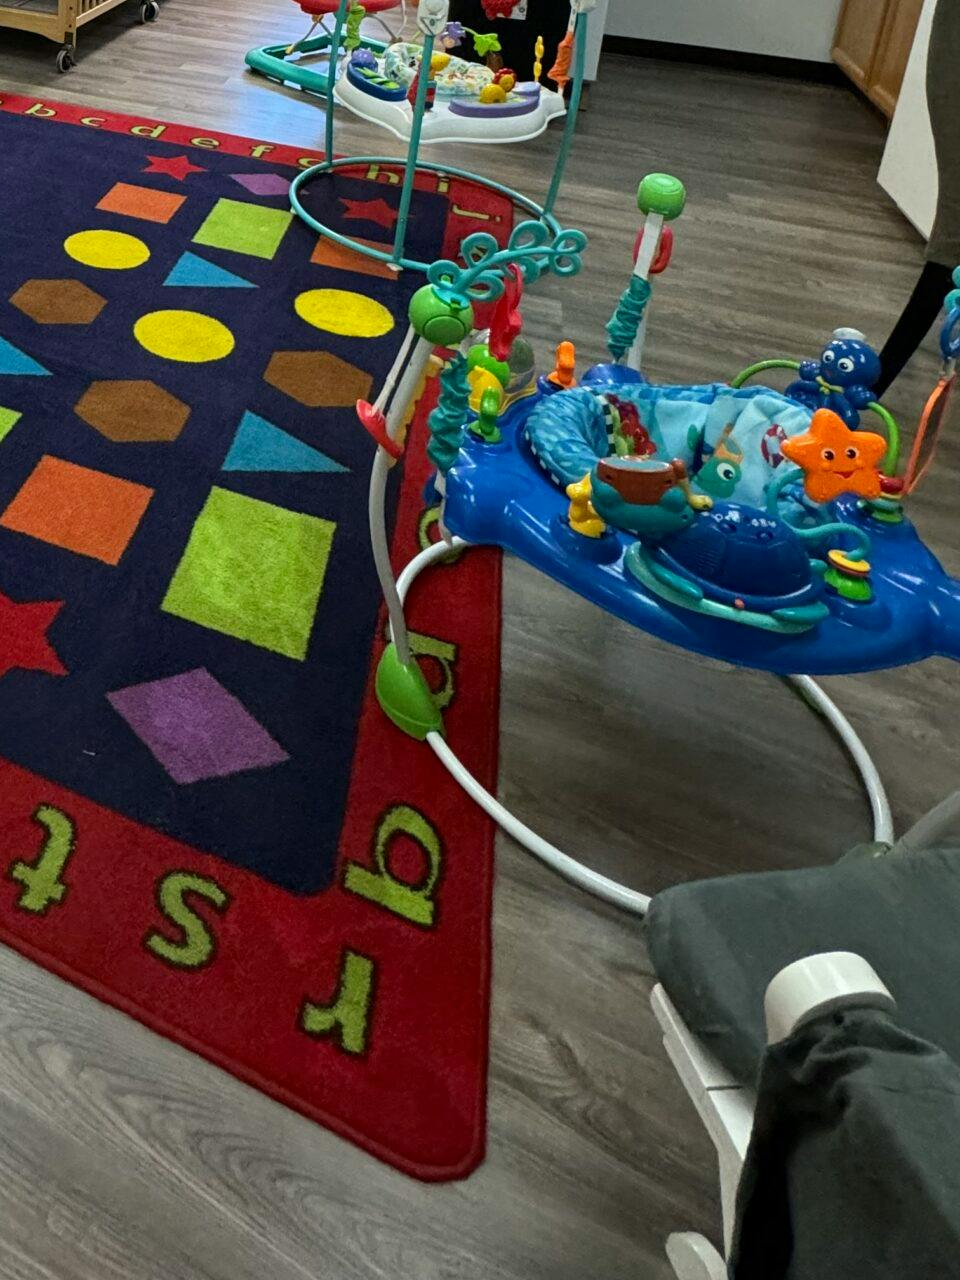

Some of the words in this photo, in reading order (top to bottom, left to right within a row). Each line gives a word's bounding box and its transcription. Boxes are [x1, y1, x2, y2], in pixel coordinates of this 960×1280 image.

[25, 103, 56, 117] b
[80, 116, 108, 127] c
[130, 124, 167, 139] d
[190, 136, 221, 149] e
[250, 146, 275, 158] f
[366, 163, 400, 185] h
[9, 805, 76, 913] t
[344, 803, 442, 927] q
[144, 870, 230, 969] s
[303, 951, 374, 1055] r
